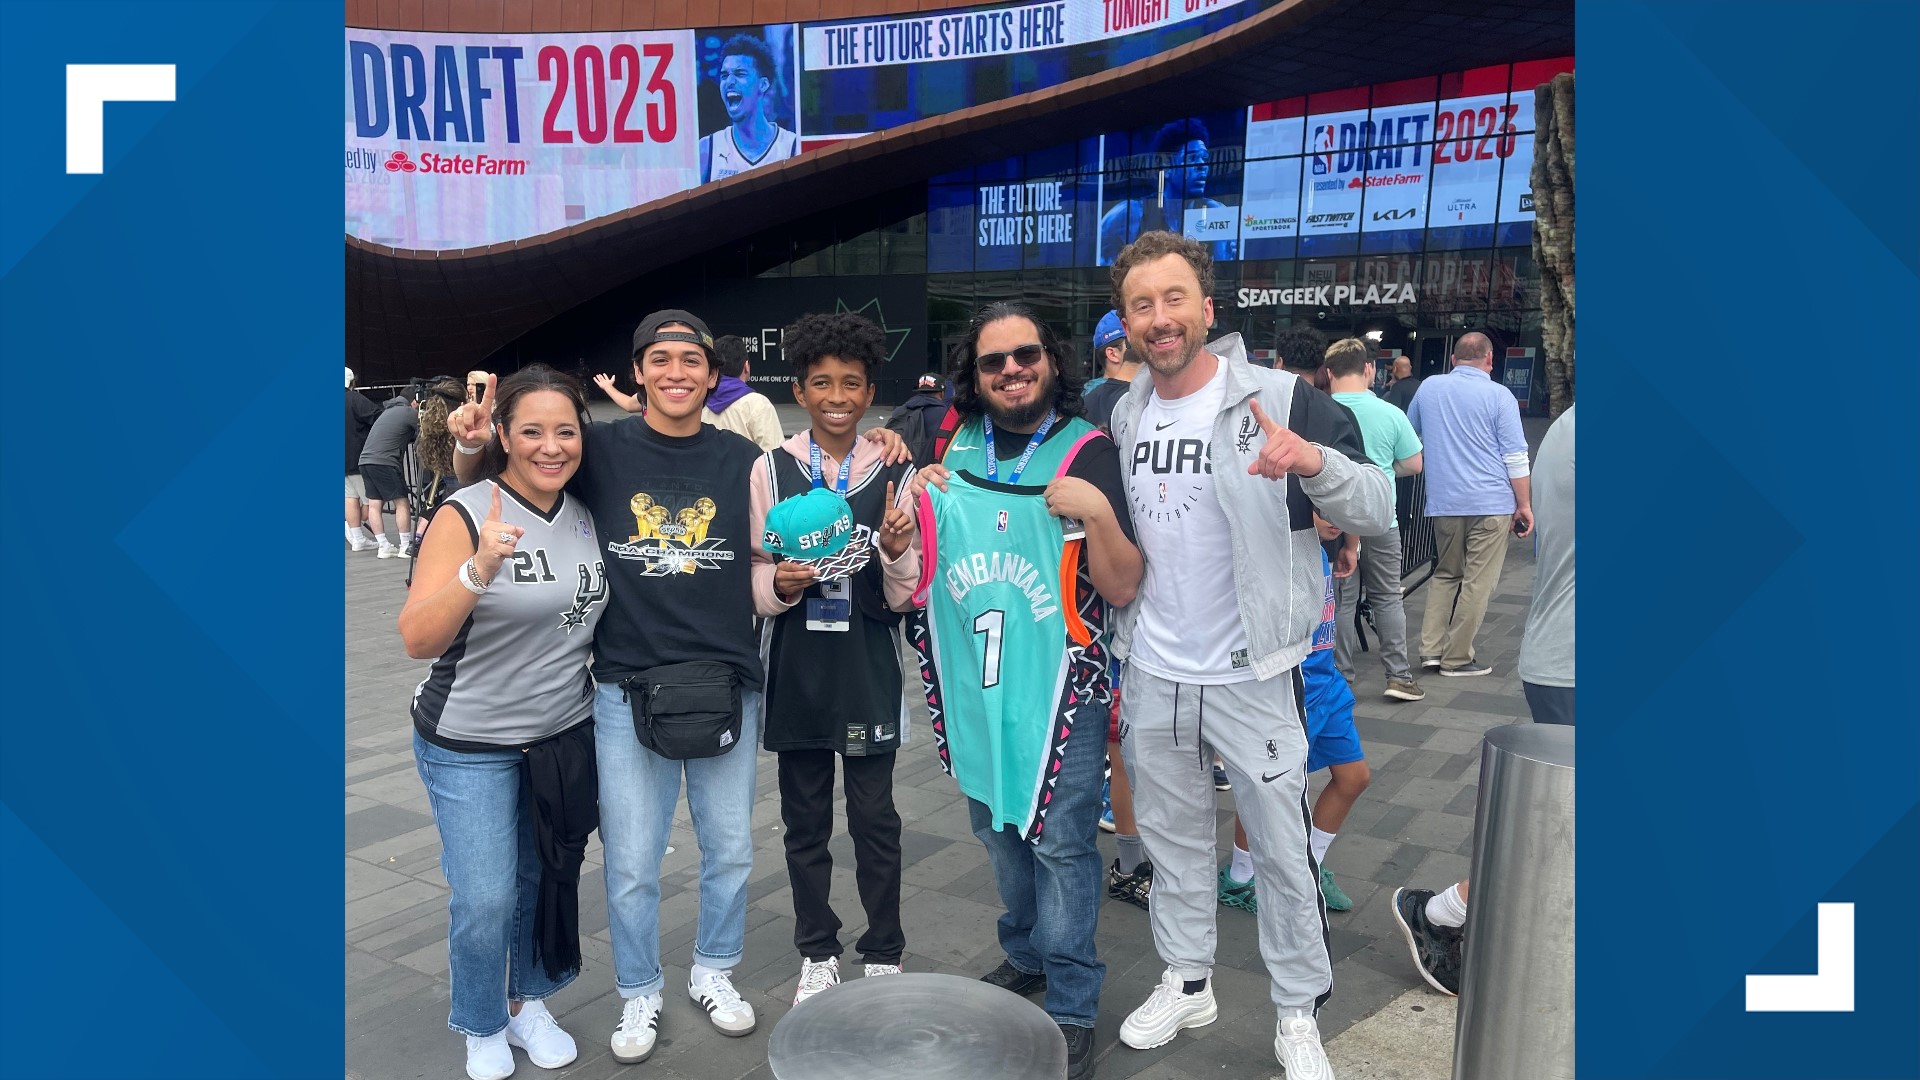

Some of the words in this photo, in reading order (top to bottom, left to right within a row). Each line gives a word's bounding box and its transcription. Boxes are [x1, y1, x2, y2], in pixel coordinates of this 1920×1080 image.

[825, 27, 858, 66] THE
[864, 20, 933, 63] FUTURE
[939, 11, 1013, 56] STARTS
[1020, 4, 1065, 48] HERE
[350, 40, 523, 144] DRAFT
[538, 43, 677, 145] 2023
[1337, 114, 1429, 173] DRAFT
[1434, 104, 1518, 164] 2023
[345, 148, 361, 169] ed
[363, 148, 376, 173] by
[980, 186, 1005, 214] THE
[1009, 182, 1063, 213] FUTURE
[1447, 203, 1477, 211] ULTRA
[979, 216, 1034, 246] STARTS
[1038, 214, 1072, 243] HERE
[1208, 221, 1230, 230] AT&T
[1305, 214, 1325, 223] FAST
[1308, 269, 1332, 280] NEW
[1237, 285, 1330, 308] SEATGEEK
[1334, 283, 1417, 305] PLAZA
[1131, 485, 1203, 522] BASKETBALL
[764, 530, 783, 548] SA
[799, 514, 850, 550] SPURS
[512, 548, 558, 584] 21
[608, 542, 639, 555] NBA
[645, 548, 734, 559] CHAMPIONS
[973, 608, 1005, 689] 1
